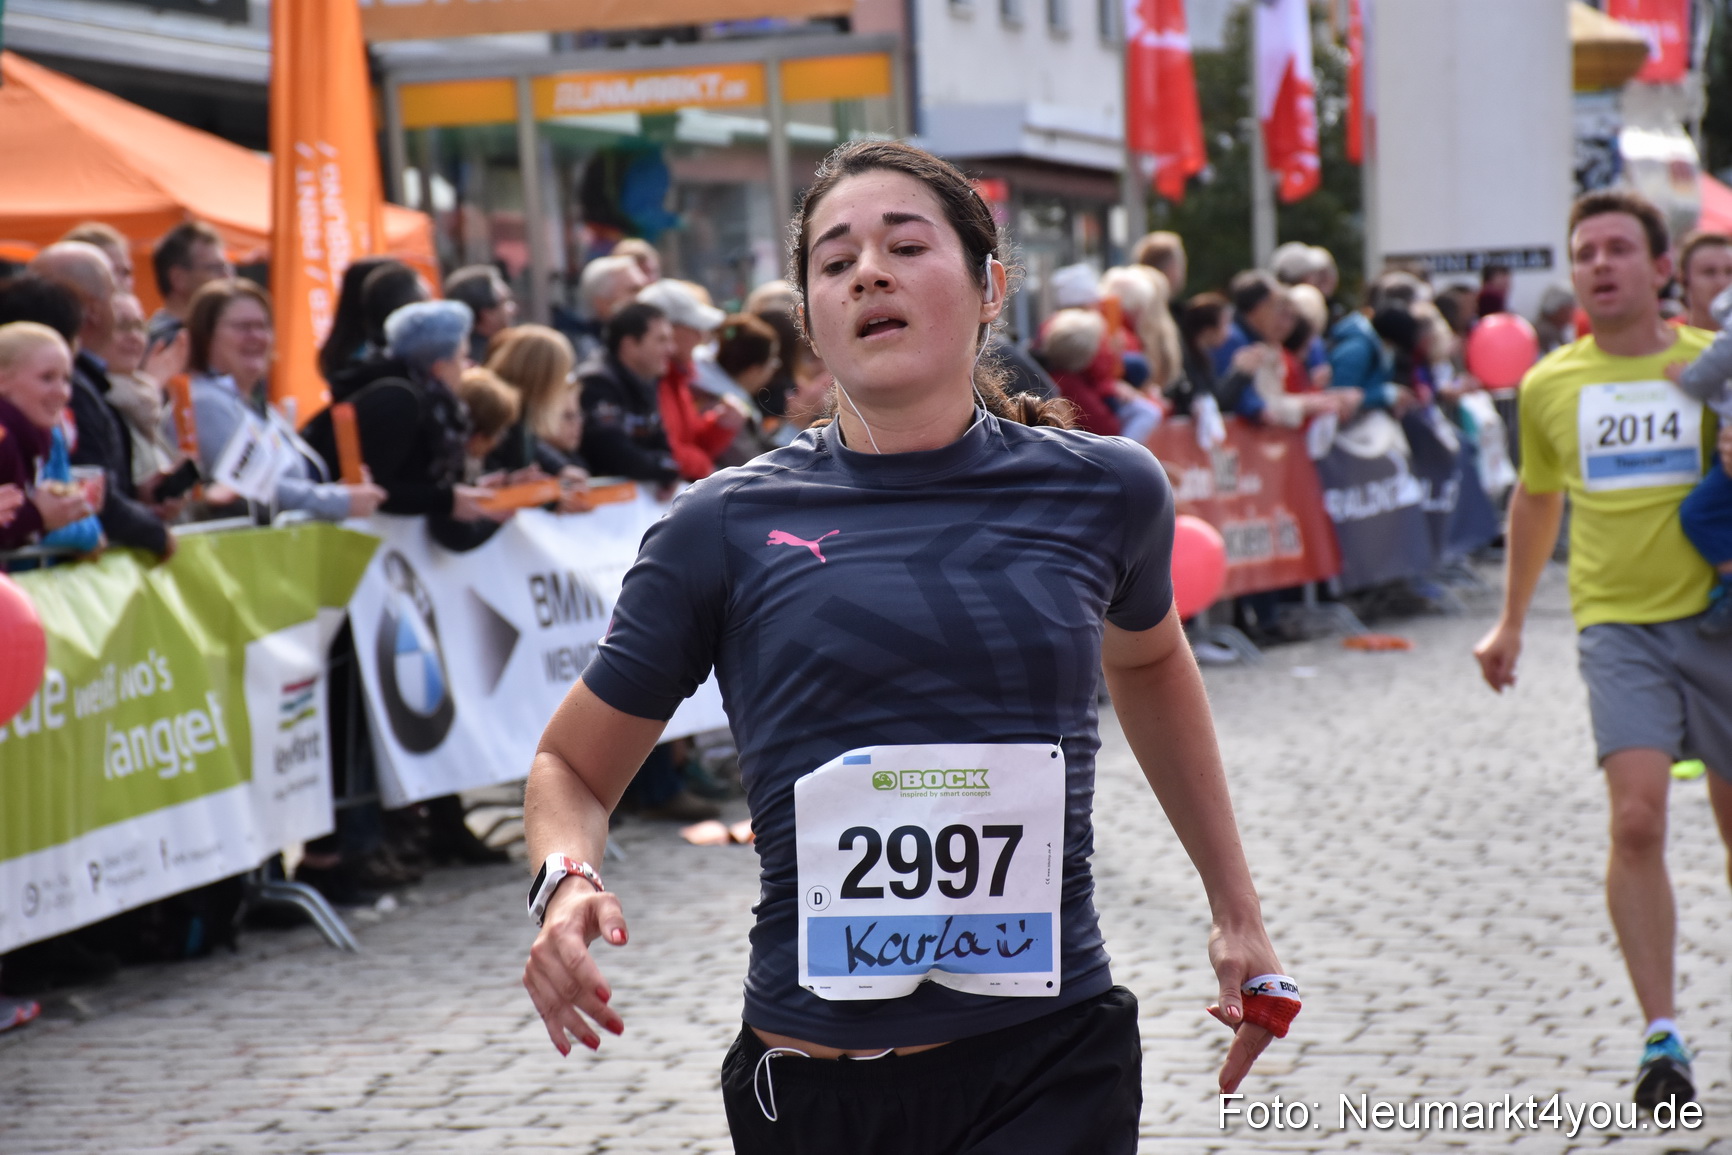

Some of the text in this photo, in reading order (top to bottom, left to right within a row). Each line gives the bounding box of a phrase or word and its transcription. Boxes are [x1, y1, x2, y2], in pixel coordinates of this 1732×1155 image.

[296, 166, 322, 260] PRINT
[318, 162, 352, 291] ERBUNG
[1598, 411, 1681, 446] 2014
[529, 570, 605, 628] BMW
[900, 769, 990, 790] BOCK
[961, 790, 991, 798] concepts
[838, 824, 1024, 899] 2997
[814, 892, 823, 905] D
[845, 915, 991, 974] Karla
